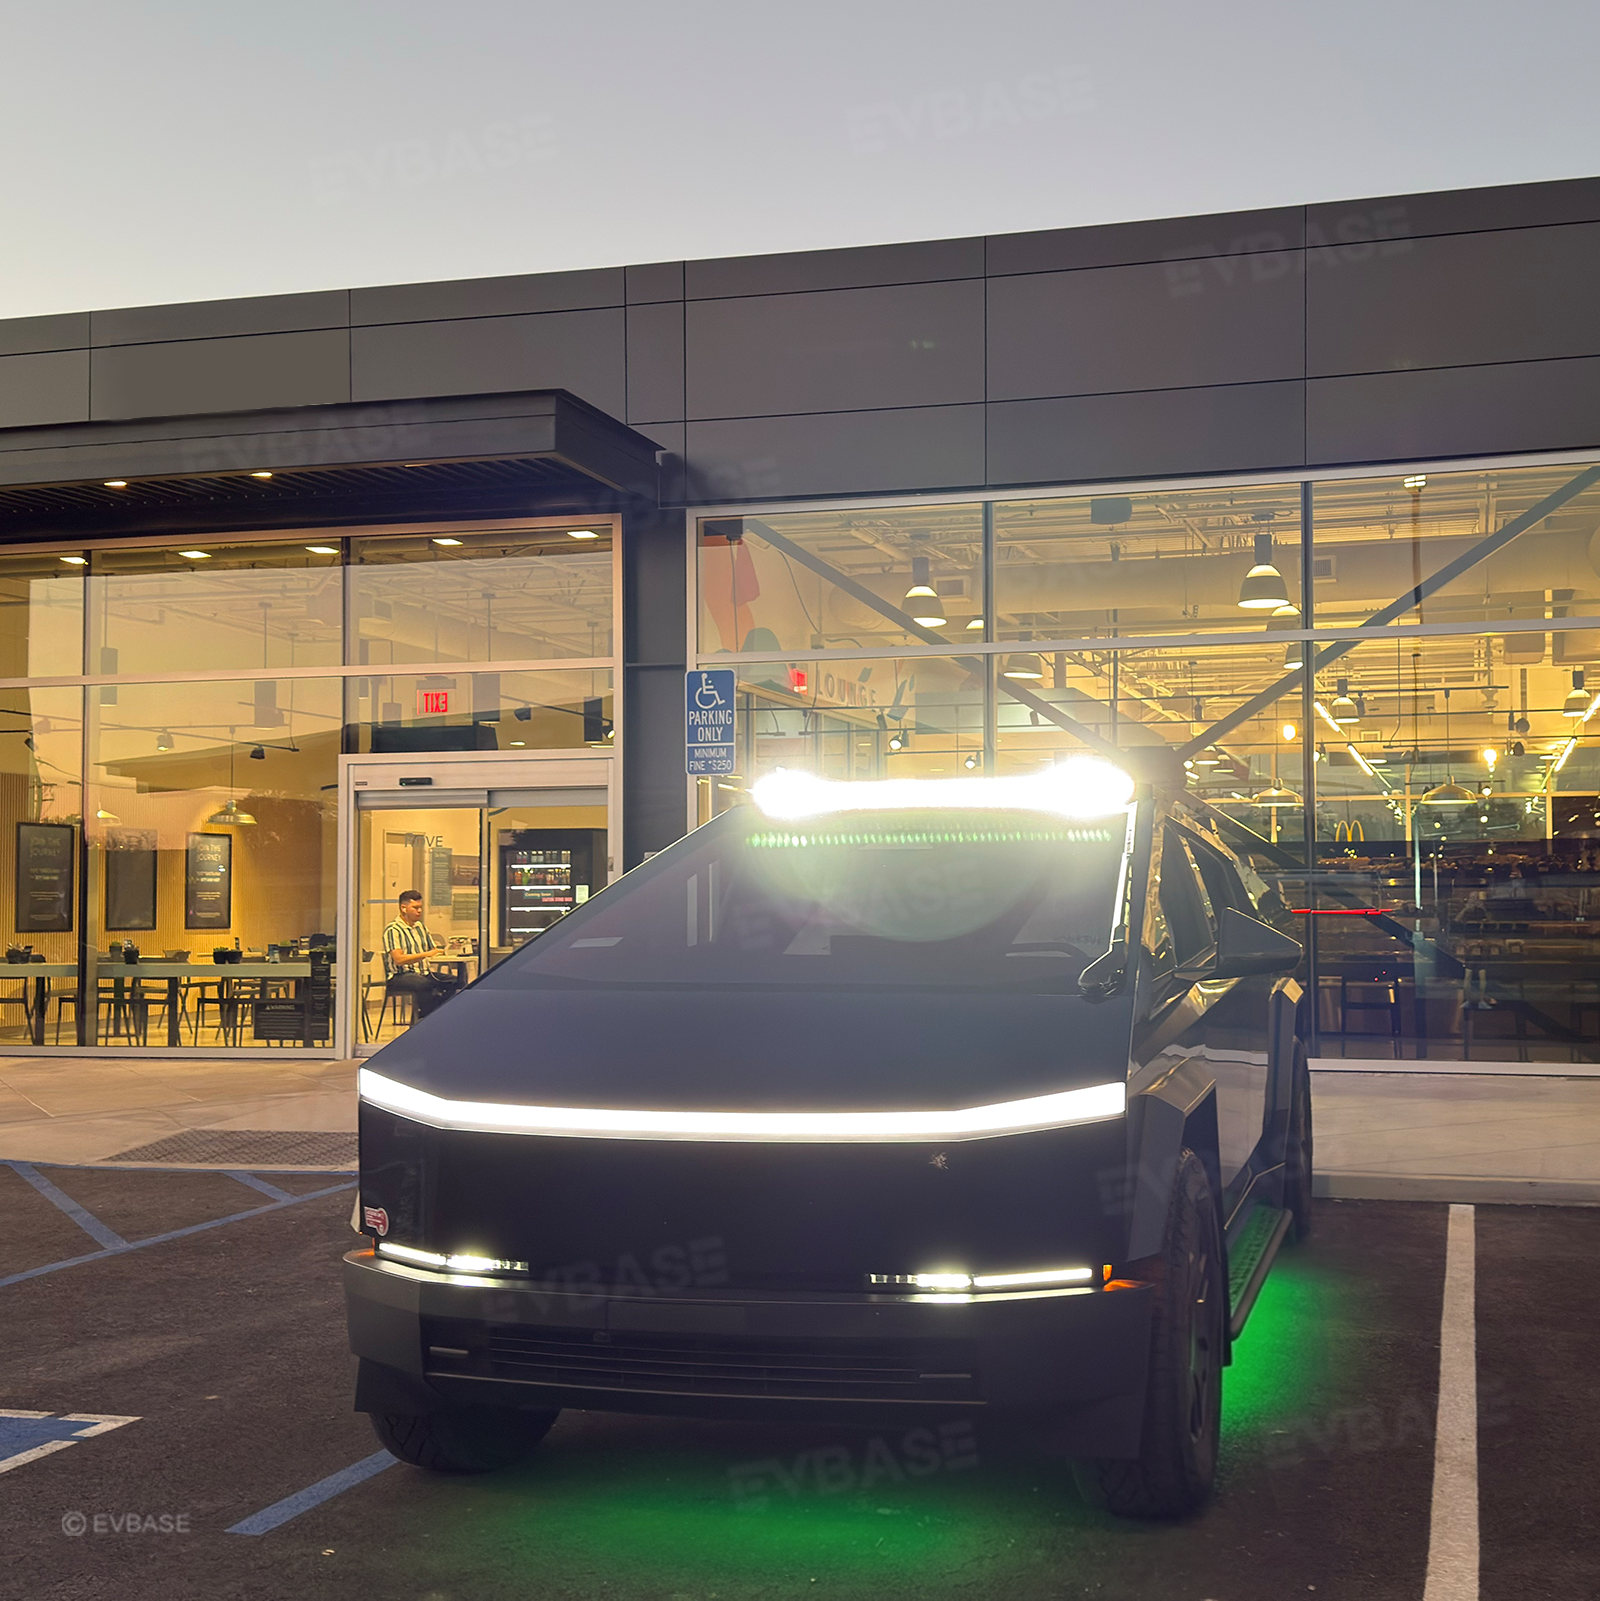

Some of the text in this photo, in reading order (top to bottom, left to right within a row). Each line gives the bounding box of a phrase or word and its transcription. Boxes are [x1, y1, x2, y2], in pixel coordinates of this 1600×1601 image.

[817, 670, 876, 712] LOUNGE
[689, 710, 732, 725] PARKING
[698, 726, 723, 742] ONLY
[694, 748, 727, 758] MINIMUM
[689, 760, 706, 771] FINE
